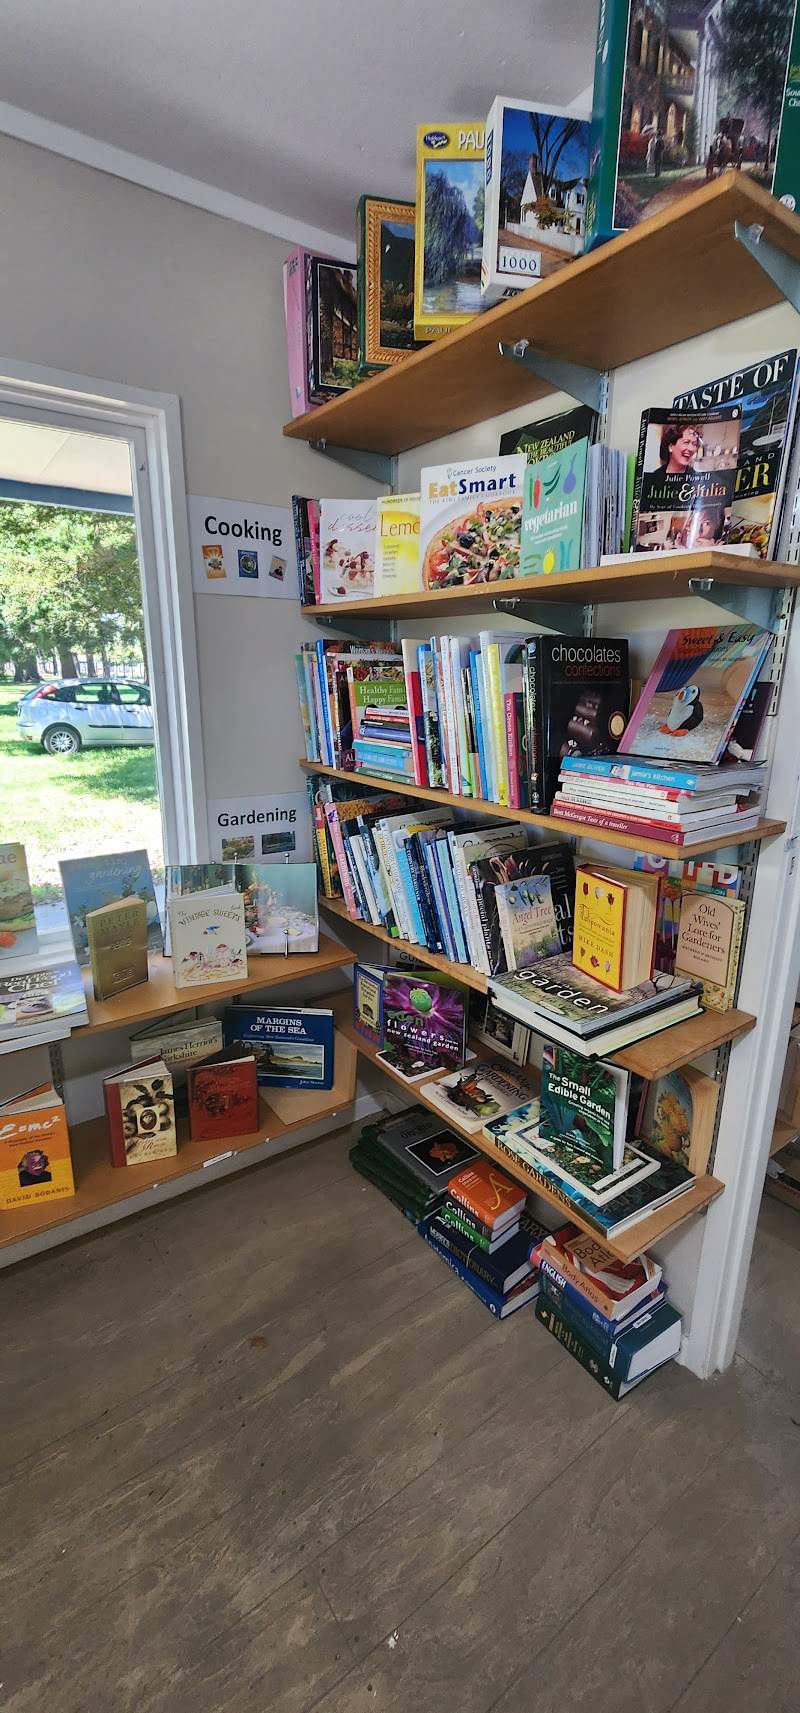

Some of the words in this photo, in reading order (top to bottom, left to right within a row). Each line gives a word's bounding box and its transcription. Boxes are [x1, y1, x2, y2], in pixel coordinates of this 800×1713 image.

[502, 255, 537, 272] 1000
[674, 373, 745, 410] TASTE
[753, 355, 789, 389] OF
[540, 430, 575, 449] ZEALAND
[453, 468, 473, 477] Cancer
[475, 465, 497, 474] Society
[665, 474, 683, 482] Julie
[685, 472, 710, 482] Powell
[428, 473, 517, 499] EatSmart
[648, 484, 679, 499] Julie
[521, 501, 578, 534] vegetarian
[205, 515, 283, 547] Cooking
[728, 631, 756, 645] Easy
[552, 643, 621, 663] chocolates
[360, 685, 387, 697] Healthy
[363, 696, 386, 705] Happy
[652, 772, 675, 782] kitchen
[217, 807, 297, 827] Gardening
[699, 903, 716, 917] Old
[693, 913, 721, 931] Wives'
[682, 931, 726, 953] Gardeners
[688, 923, 708, 938] Lore
[709, 930, 721, 942] for
[515, 967, 609, 1015] garden
[250, 1024, 263, 1032] OF
[265, 1025, 286, 1033] THE
[288, 1026, 307, 1035] SEA
[256, 1016, 302, 1027] MARGINS
[387, 1019, 445, 1041] flowers
[184, 1036, 218, 1050] Herriot's
[386, 1028, 401, 1036] new
[403, 1032, 431, 1044] zealand
[433, 1040, 459, 1051] garden
[548, 1072, 561, 1081] The
[561, 1076, 591, 1097] Small
[548, 1082, 578, 1101] Edible
[579, 1095, 611, 1120] Garden
[495, 1138, 522, 1169] ROSE
[520, 1158, 572, 1208] GARDENS
[6, 1194, 31, 1204] DAVID
[35, 1186, 70, 1198] BODANIS
[488, 1172, 513, 1211] A
[450, 1188, 480, 1218] Collins
[446, 1201, 476, 1229] Collins
[443, 1214, 475, 1242] Collins
[541, 1260, 567, 1288] ENGLISH
